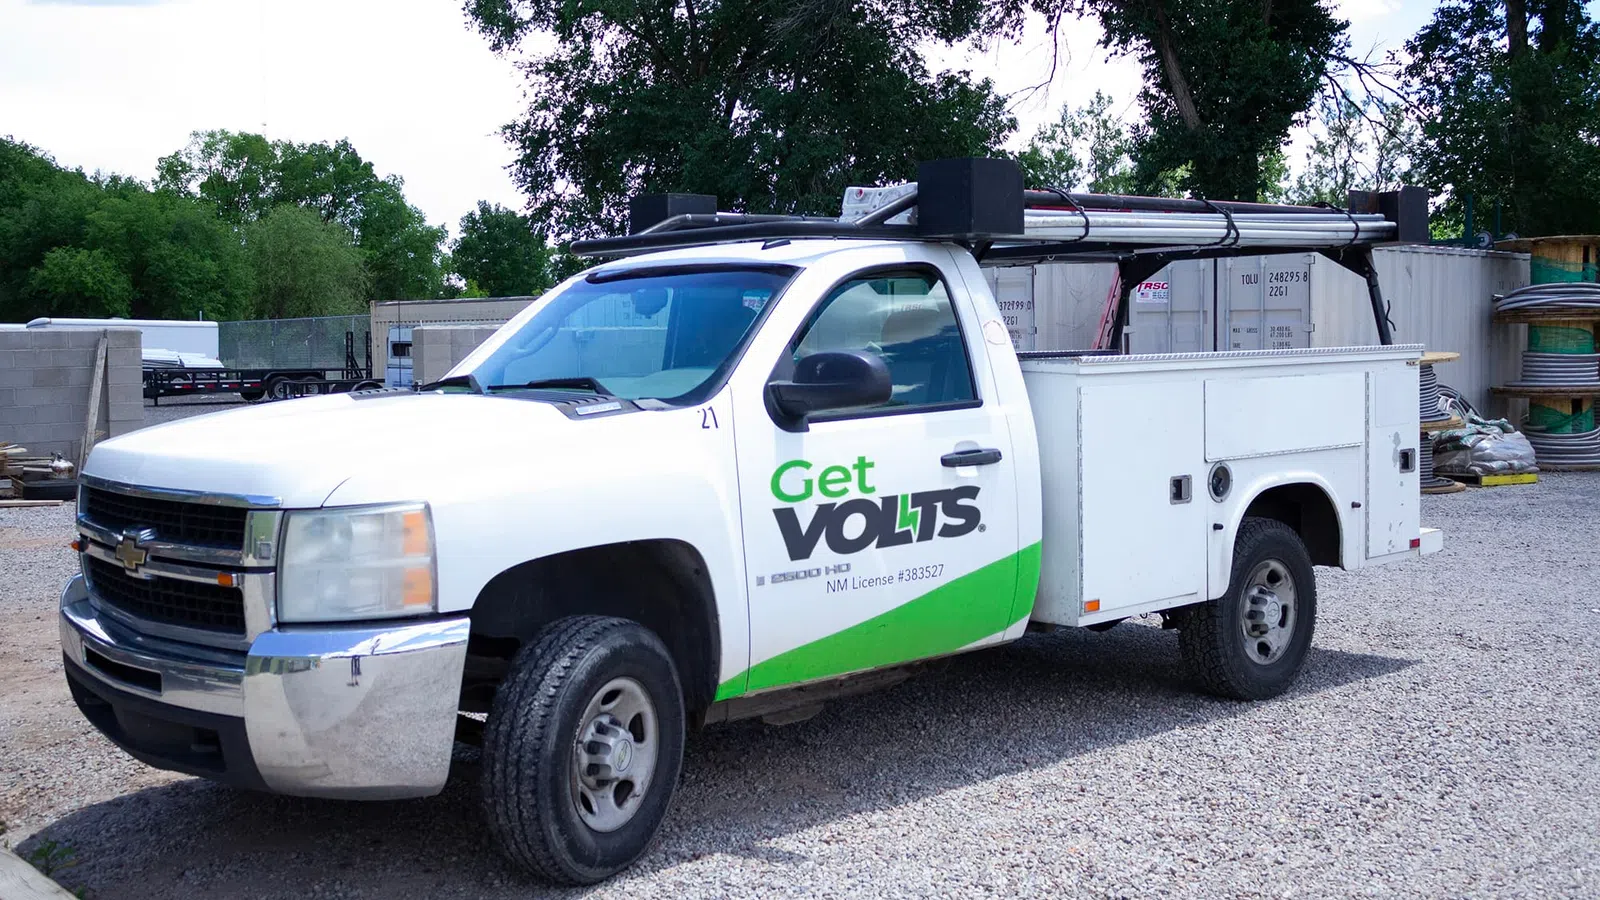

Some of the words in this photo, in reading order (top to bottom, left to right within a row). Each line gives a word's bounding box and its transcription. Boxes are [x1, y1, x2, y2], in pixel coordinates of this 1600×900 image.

[1241, 273, 1259, 285] TOLU
[1269, 271, 1300, 283] 248295
[1269, 285, 1288, 297] 22G1
[701, 406, 718, 429] 21
[770, 456, 876, 502] Get
[772, 485, 982, 562] VOLTS
[770, 567, 821, 584] 2500
[825, 562, 851, 576] HD
[826, 577, 848, 594] NM
[852, 575, 894, 590] License
[898, 563, 945, 582] #383527
